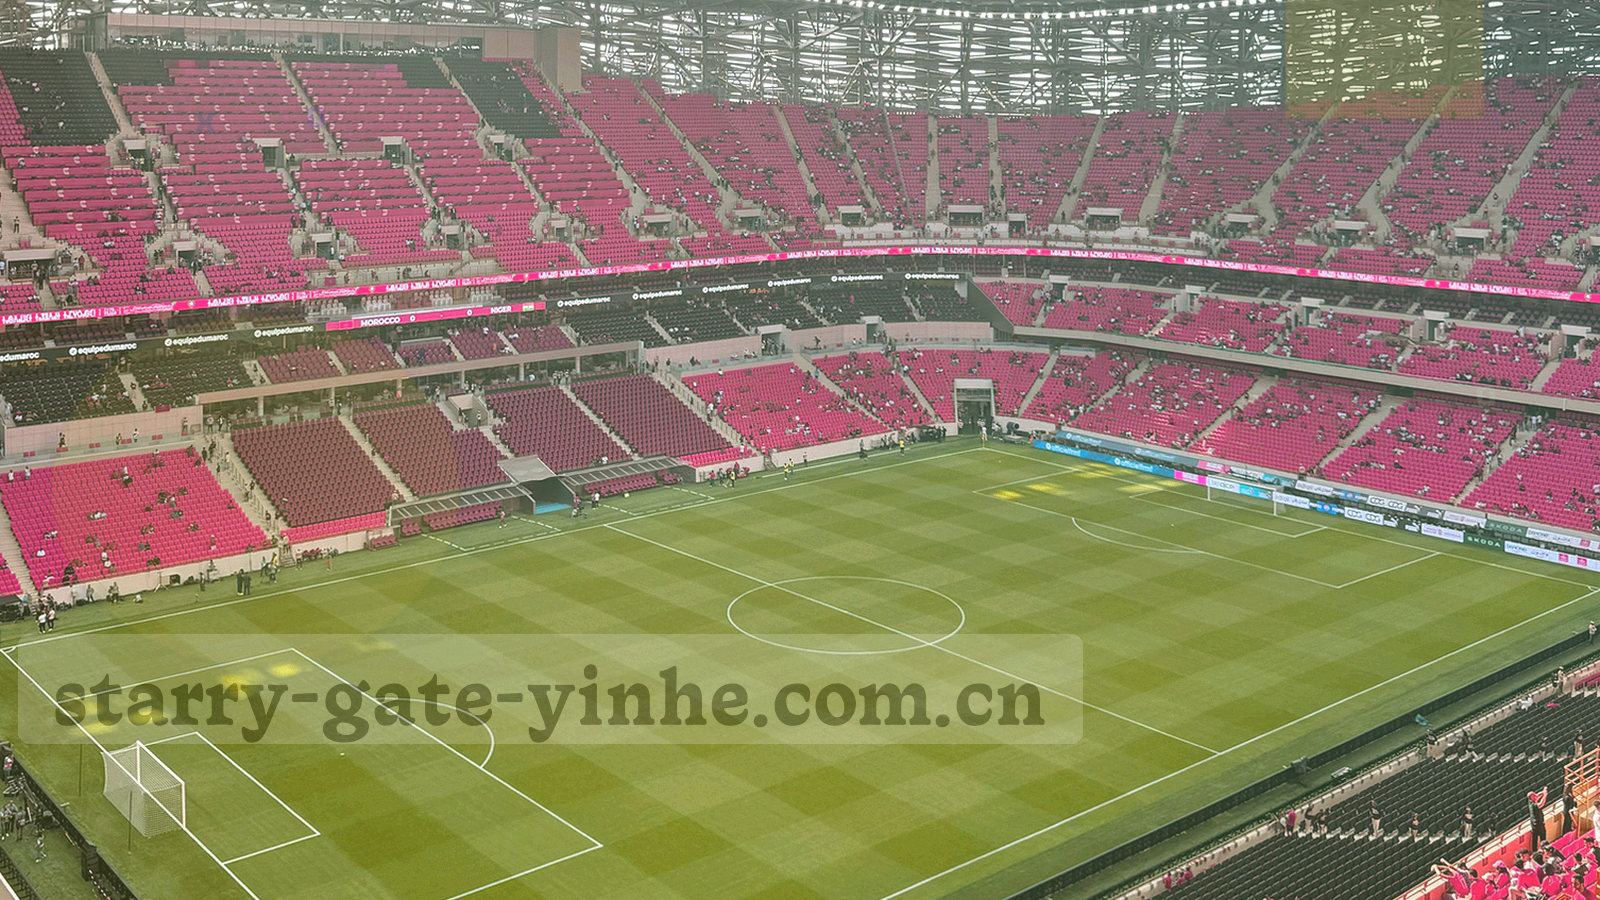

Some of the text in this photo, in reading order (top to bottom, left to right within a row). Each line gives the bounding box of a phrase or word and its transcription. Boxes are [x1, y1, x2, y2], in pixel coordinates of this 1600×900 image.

[361, 316, 401, 327] MOROCCO
[490, 305, 512, 314] NIGER
[262, 326, 314, 338] equipedumaroc
[172, 334, 229, 347] equipedumaroc
[77, 342, 138, 355] equipedumaroc
